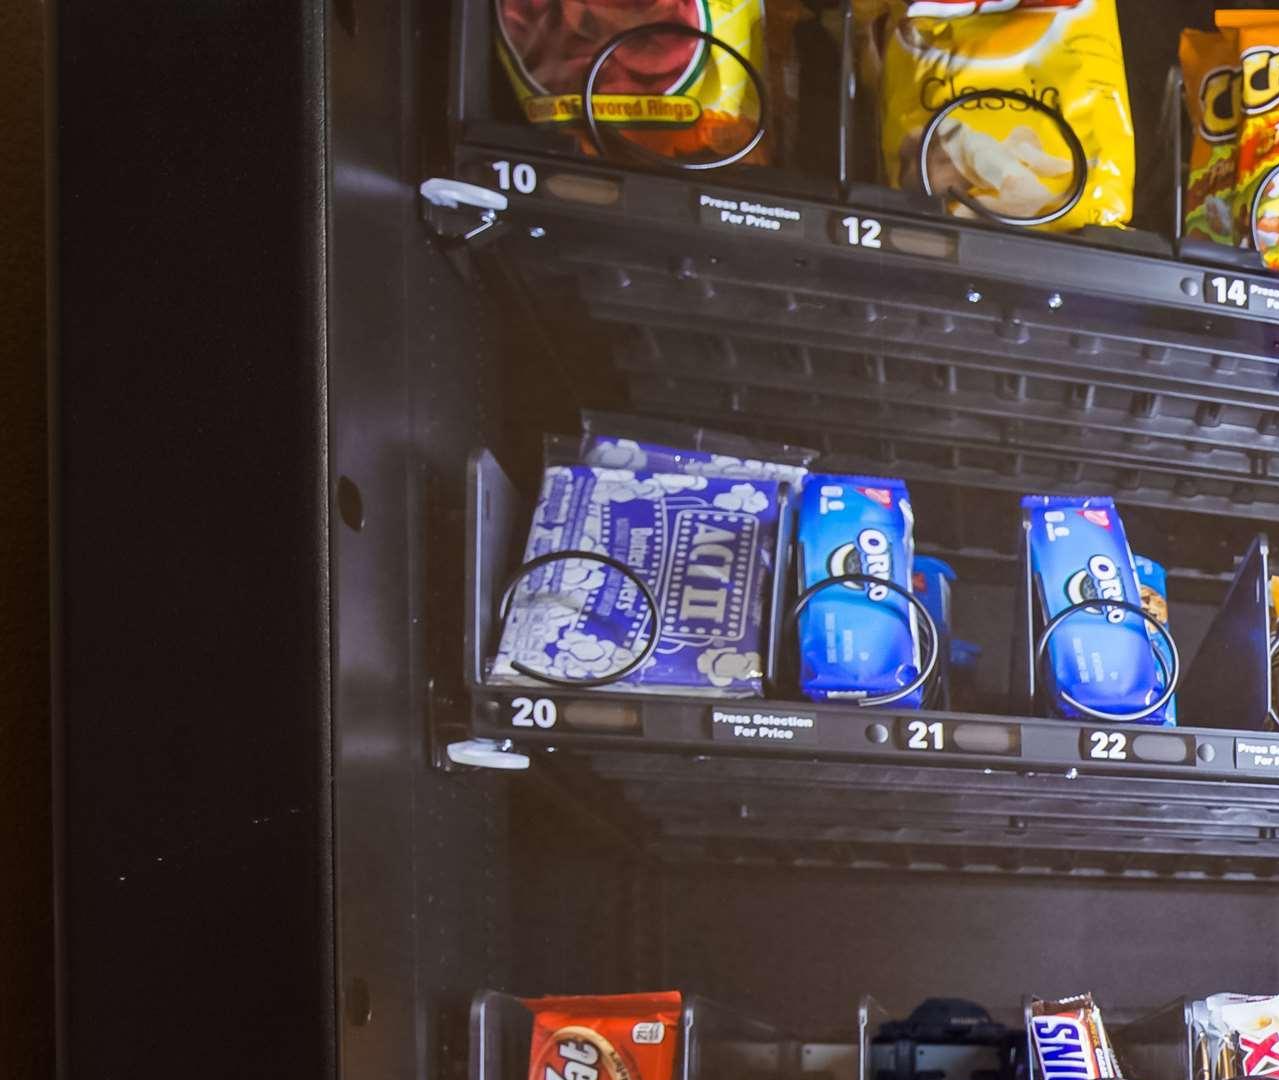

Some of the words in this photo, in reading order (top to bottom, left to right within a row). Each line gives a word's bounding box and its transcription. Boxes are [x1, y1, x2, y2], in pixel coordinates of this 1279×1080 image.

[492, 161, 538, 194] 10
[745, 213, 781, 231] Price
[842, 216, 882, 249] 12
[1211, 276, 1248, 307] 14
[686, 521, 735, 583] ACT
[511, 697, 558, 728] 20
[713, 712, 750, 726] Press
[753, 713, 813, 729] Selection
[734, 725, 757, 738] For
[758, 726, 794, 740] Price
[907, 722, 945, 751] 21
[1089, 731, 1127, 760] 22
